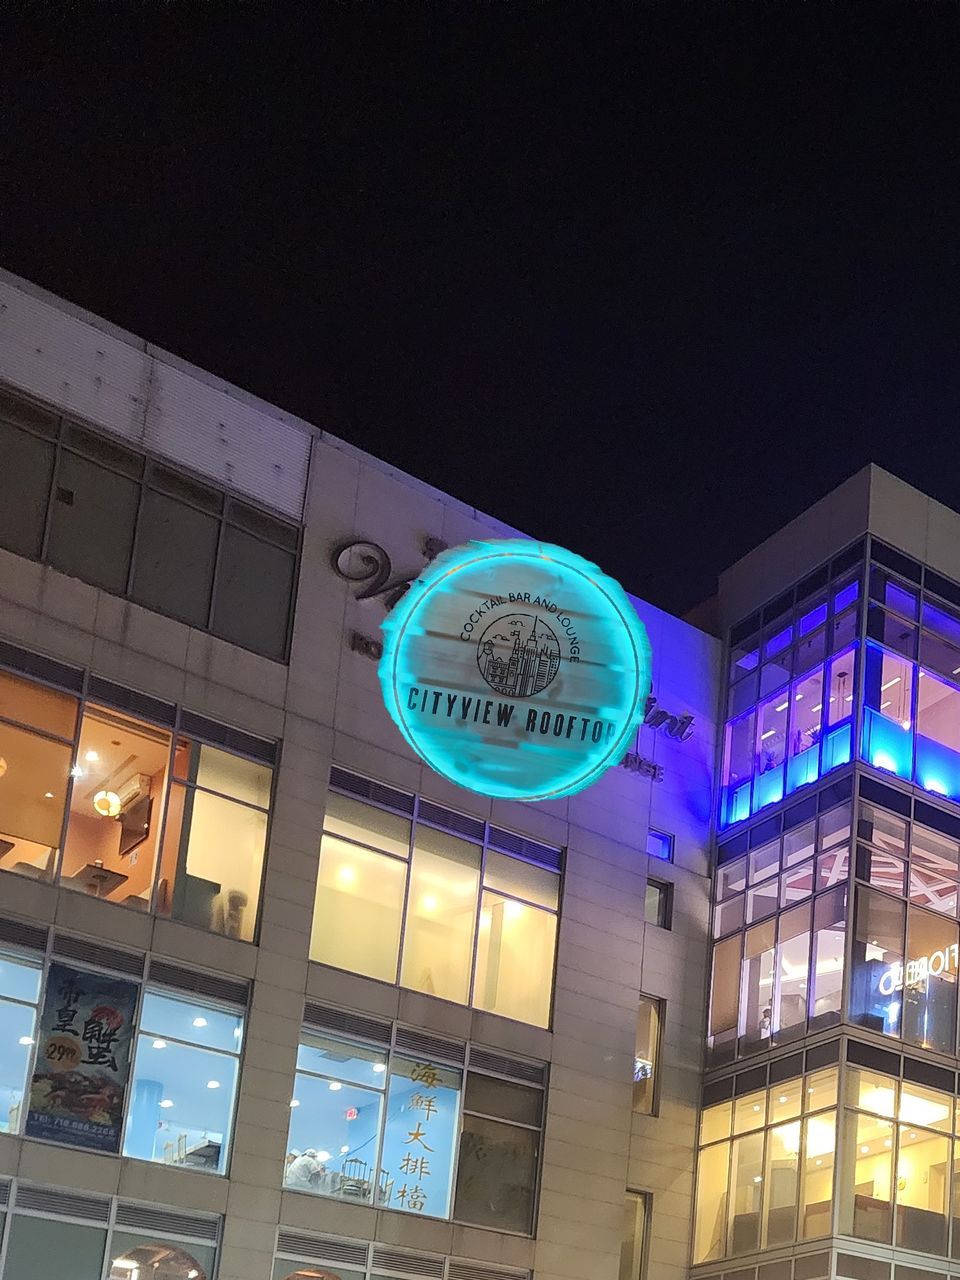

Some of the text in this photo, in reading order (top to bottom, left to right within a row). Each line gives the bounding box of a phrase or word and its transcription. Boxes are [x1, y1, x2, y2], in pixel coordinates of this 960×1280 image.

[460, 592, 581, 663] COCKTAIL BAR AND LOUNGE
[407, 687, 616, 745] CITYVIEW ROOFTOP
[394, 1062, 443, 1212] 海鮮大排檔
